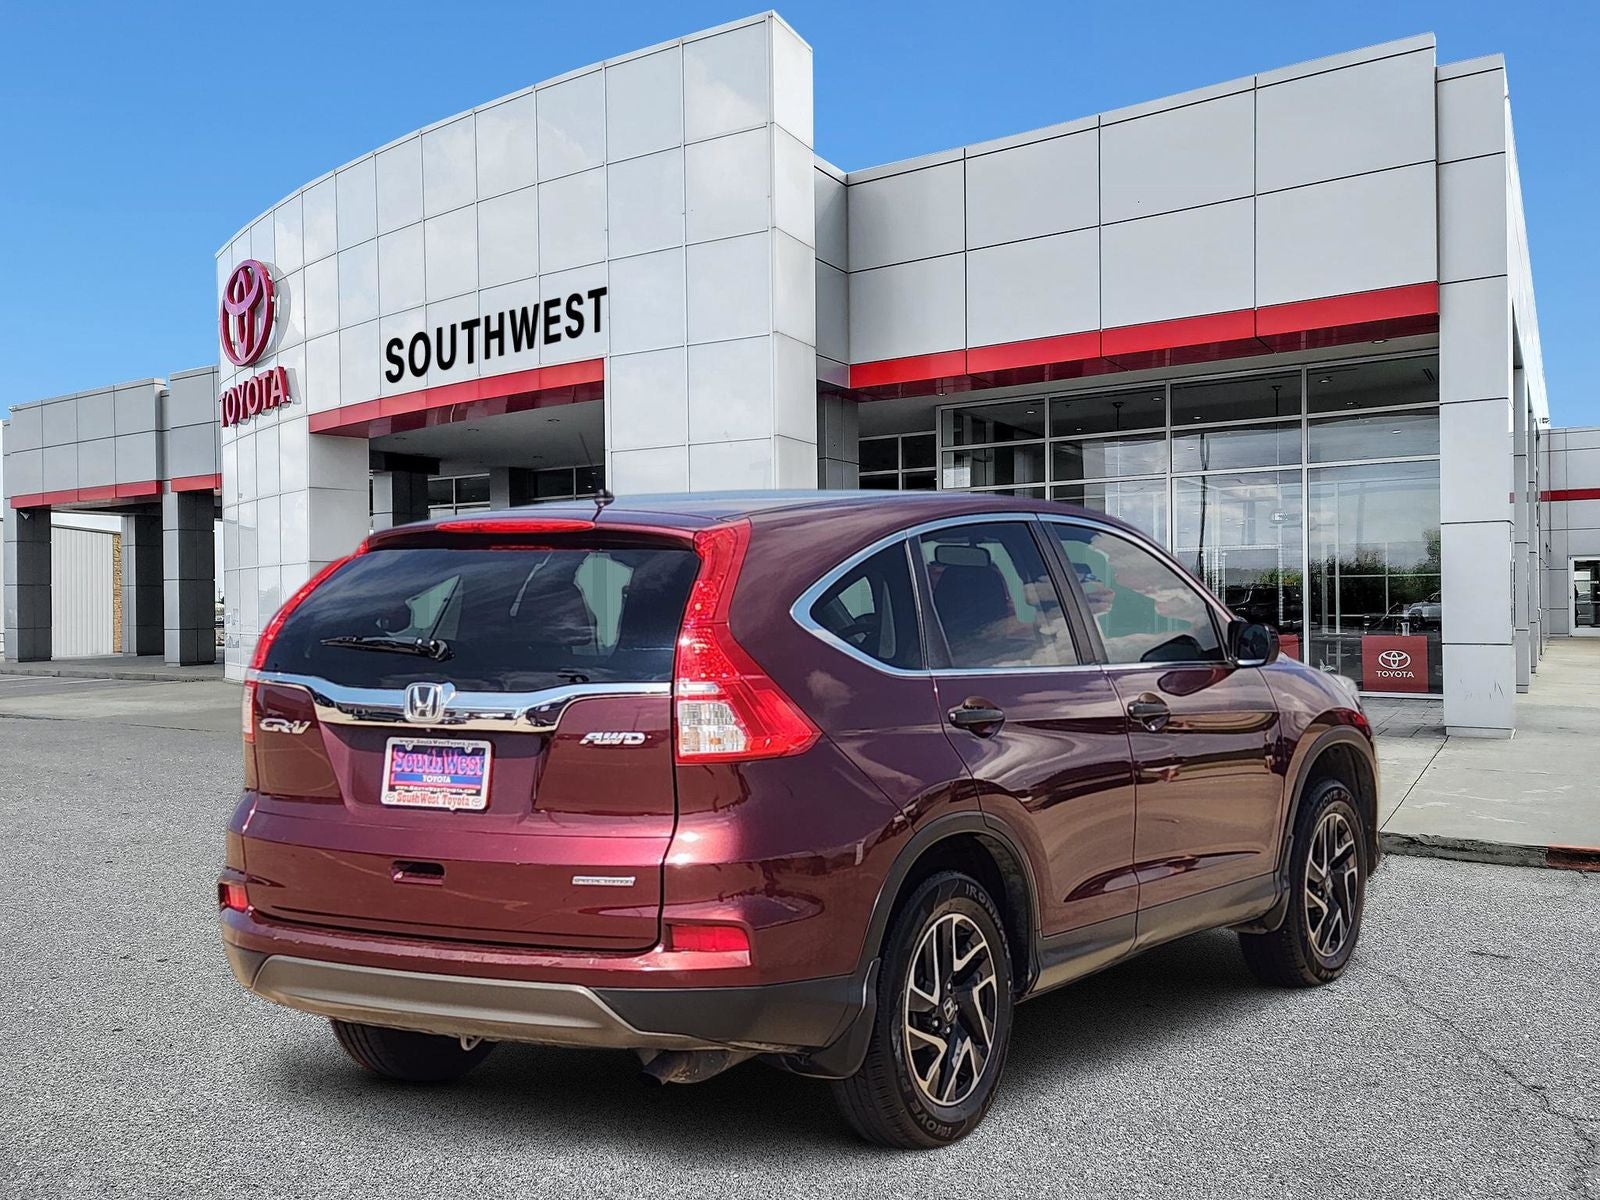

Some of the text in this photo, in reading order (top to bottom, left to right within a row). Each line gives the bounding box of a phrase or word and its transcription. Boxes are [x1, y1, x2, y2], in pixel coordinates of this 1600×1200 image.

[385, 286, 608, 384] SOUTHWEST
[218, 366, 289, 428] TOYOTA
[1375, 670, 1415, 678] TOYOTA
[579, 731, 646, 745] AWD
[422, 775, 452, 784] TOYOTA
[442, 794, 471, 808] Toyota
